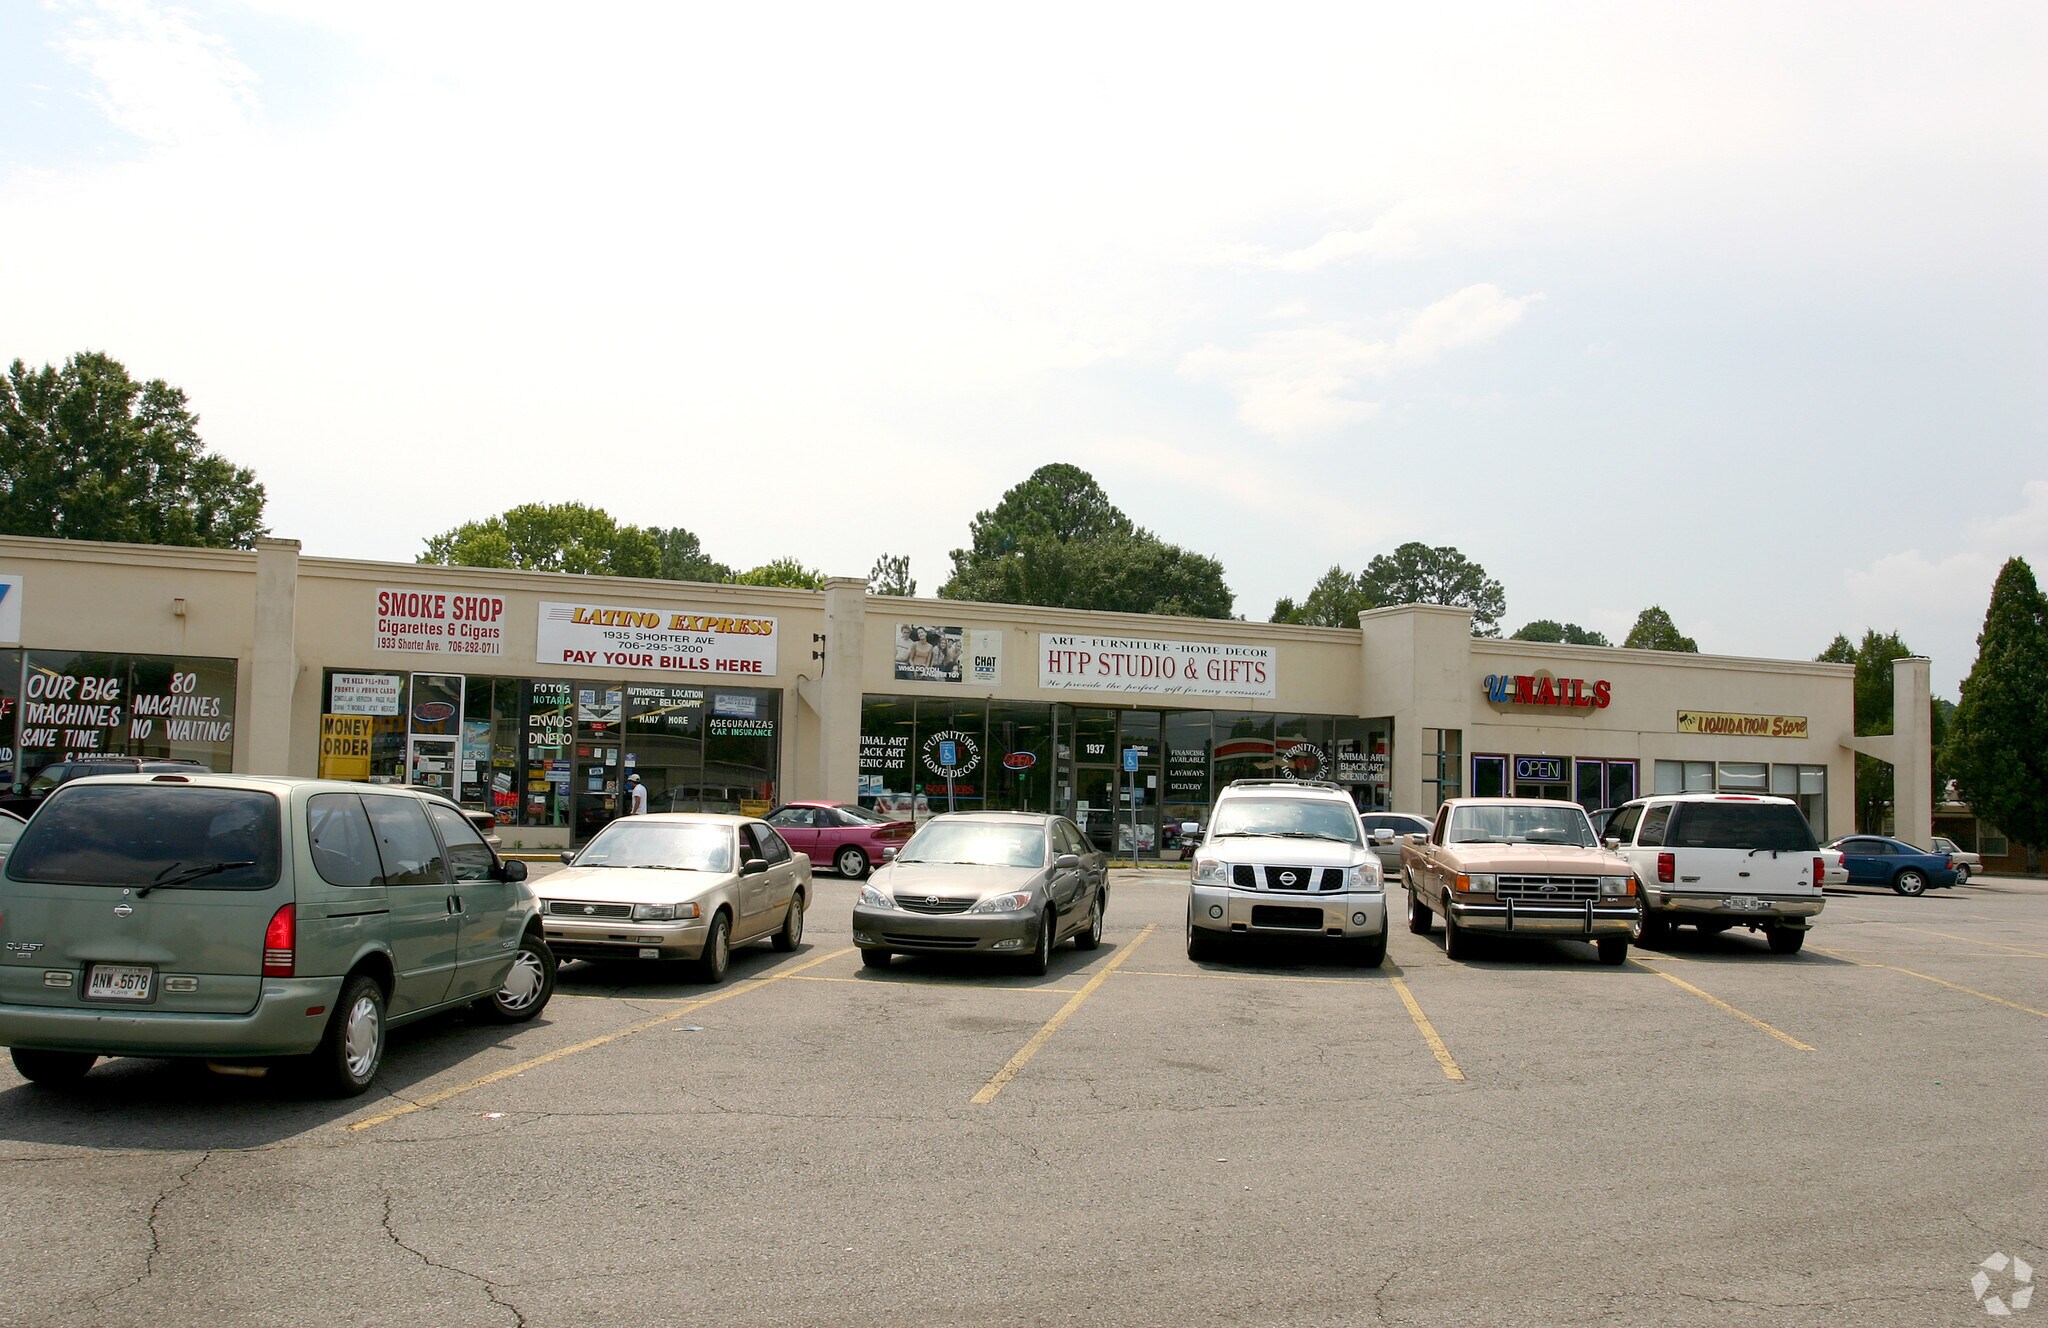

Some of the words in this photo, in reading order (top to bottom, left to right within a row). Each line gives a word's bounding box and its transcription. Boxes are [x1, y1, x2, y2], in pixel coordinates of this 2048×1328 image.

[378, 592, 446, 619] SMOKE
[452, 596, 503, 622] SHOP
[378, 619, 443, 636] Cigarettes
[447, 623, 455, 636] &
[460, 623, 500, 640] Cigars
[571, 607, 660, 629] LATINO
[667, 614, 774, 636] EXPRESS
[377, 637, 396, 649] 1933
[398, 638, 424, 651] Shorter
[426, 640, 441, 651] Ave.
[448, 640, 500, 654] 706-292-0711
[603, 631, 631, 640] 1935
[635, 632, 690, 643] SHORTER
[694, 637, 715, 645] AVE
[618, 641, 704, 654] 706-295-3200
[1049, 637, 1076, 645] ART
[1092, 638, 1170, 651] FURNITURE
[1226, 647, 1268, 657] DECOR
[563, 649, 597, 663] PAY
[603, 652, 654, 667] YOUR
[660, 656, 710, 670] BILLS
[716, 659, 762, 673] HERE
[975, 656, 996, 667] CHAT
[1048, 650, 1092, 675] HTP
[1097, 652, 1176, 678] STUDIO
[1184, 657, 1199, 680] &
[1207, 658, 1266, 683] GIFTS
[27, 675, 76, 700] OUR
[80, 677, 120, 700] BIG
[171, 672, 196, 693] 80
[533, 683, 571, 694] FOTOS
[1063, 680, 1101, 689] provide
[1124, 683, 1160, 692] perfect
[1164, 686, 1182, 694] gift
[1184, 686, 1197, 695] for
[533, 695, 572, 705] NOTARIA
[627, 687, 665, 697] AUTHORIZE
[672, 689, 704, 698] LOCATION
[1514, 675, 1611, 709] NAILS
[134, 694, 220, 717] MACHINES
[415, 703, 452, 719] OPEN
[659, 698, 700, 708] BELLSOUTH
[27, 703, 121, 727] MACHINES
[529, 715, 573, 728] ENVIOS
[639, 715, 659, 723] MANY
[668, 716, 688, 725] MORE
[130, 719, 152, 739] NO
[166, 720, 231, 742] WAITING
[324, 718, 370, 736] MONEY
[710, 719, 773, 729] ASEGURANZAS
[731, 728, 773, 736] INSURANCE
[1697, 716, 1769, 734] LIQUIDATION
[1772, 716, 1806, 736] Store
[20, 728, 58, 747] SAVE
[64, 729, 99, 748] TIME
[528, 732, 572, 745] DINERO
[860, 736, 886, 745] IMAL
[888, 737, 909, 746] ART
[923, 730, 978, 754] FURNITURE
[323, 738, 368, 756] ORDER
[860, 748, 883, 756] ACK
[885, 748, 906, 757] ART
[1086, 744, 1105, 754] 1937
[1282, 743, 1328, 764] FURNITURE
[859, 759, 882, 768] ENIC
[884, 760, 906, 768] ART
[1003, 753, 1033, 768] OPEN
[1338, 753, 1368, 761] ANIMAL
[922, 754, 948, 778] HOME
[950, 755, 981, 778] DECOR
[1340, 763, 1366, 771] BLACK
[1368, 764, 1384, 772] ART
[1518, 760, 1559, 778] OPEN
[1281, 765, 1301, 784] HOM
[1340, 773, 1367, 781] SCENIC
[1369, 773, 1384, 781] ART
[6, 942, 44, 951] QUEST
[120, 974, 148, 990] 5678
